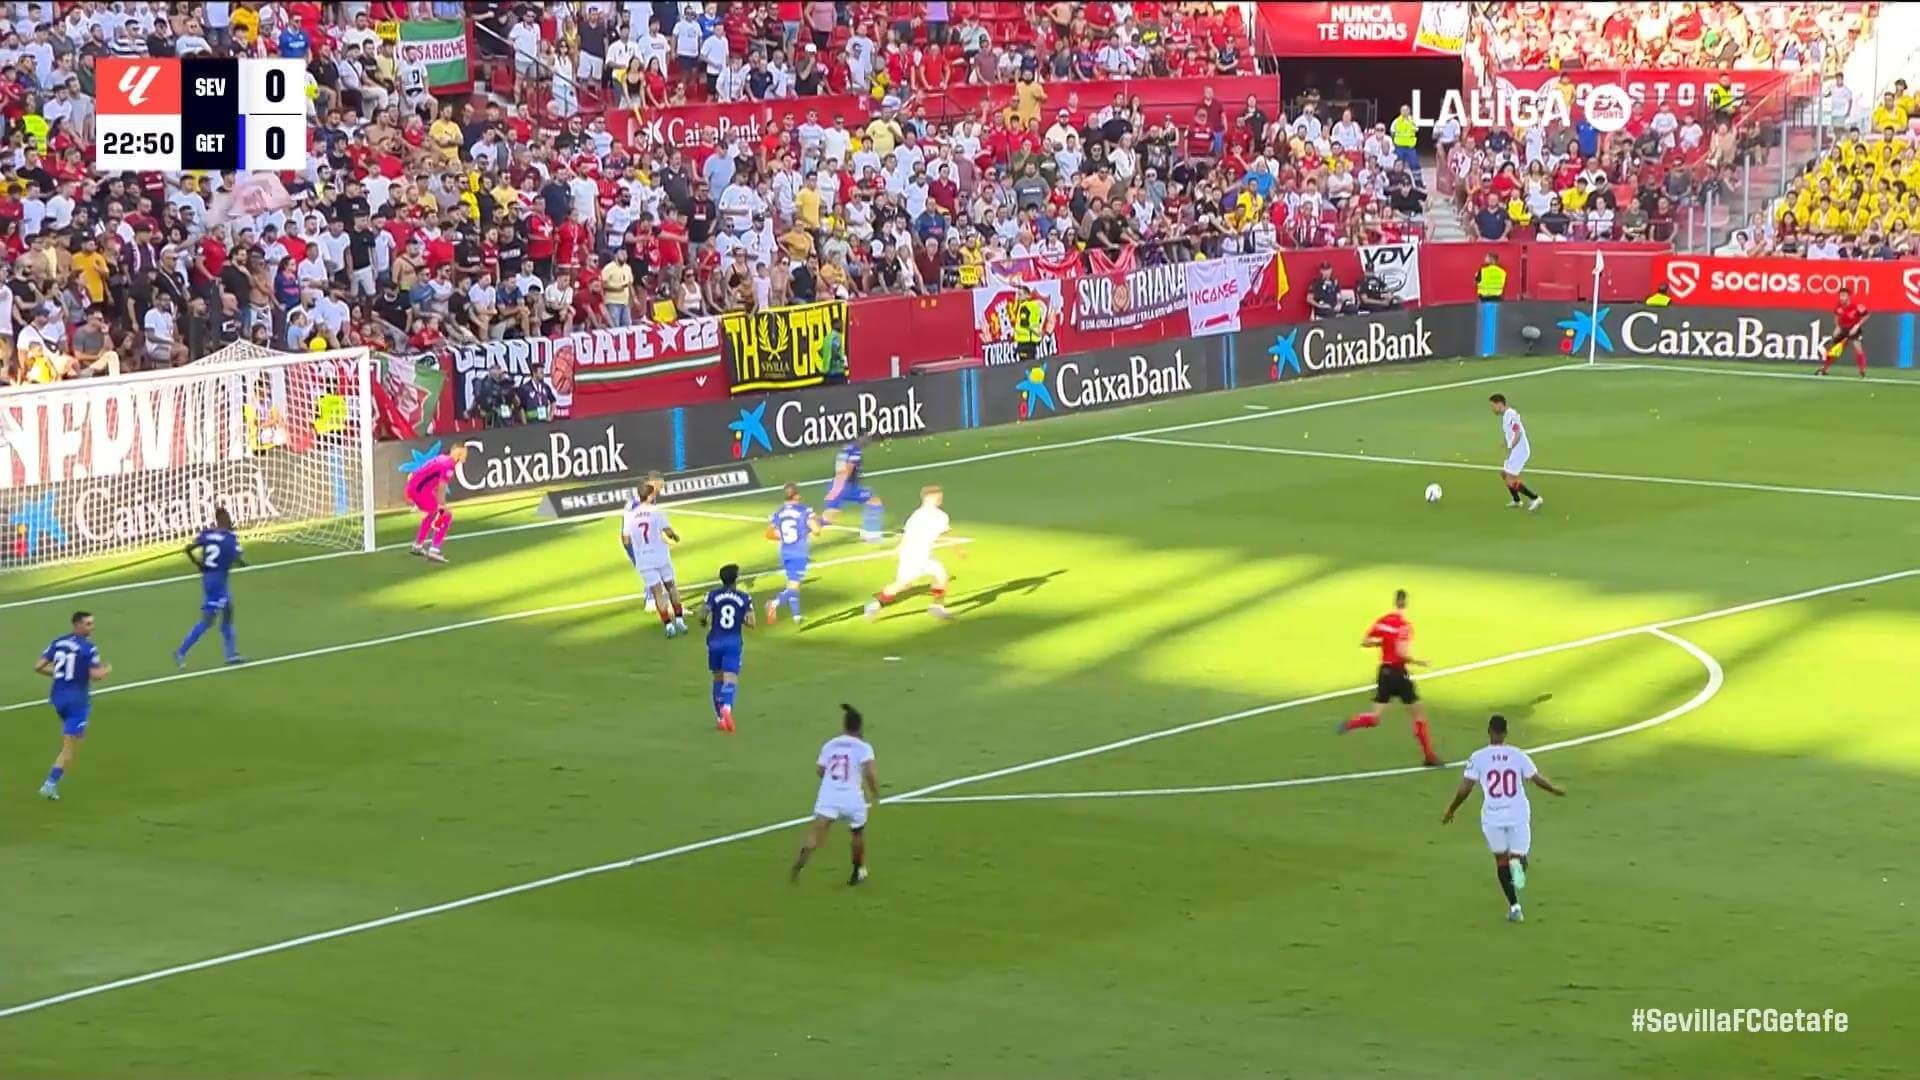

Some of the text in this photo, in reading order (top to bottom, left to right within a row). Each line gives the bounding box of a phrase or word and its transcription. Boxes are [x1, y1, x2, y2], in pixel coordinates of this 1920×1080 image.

[1330, 6, 1393, 23] NUNCA
[1317, 23, 1339, 41] TE
[1343, 22, 1408, 41] RINDAS
[667, 113, 762, 147] CaiaBank
[1078, 277, 1114, 317] SVQ
[1302, 316, 1435, 371] CaixaBank
[1620, 311, 1834, 362] CaixaBank
[1056, 348, 1193, 408] CaixaBank
[775, 387, 926, 447] CaixaBank
[455, 424, 629, 490] CaixaBank
[560, 486, 639, 511] SKECHE
[638, 522, 649, 544] 7
[781, 519, 798, 545] 5
[205, 543, 220, 568] 2
[720, 604, 736, 630] 8
[53, 650, 77, 682] 21
[830, 753, 849, 783] 21
[1486, 768, 1518, 798] 20
